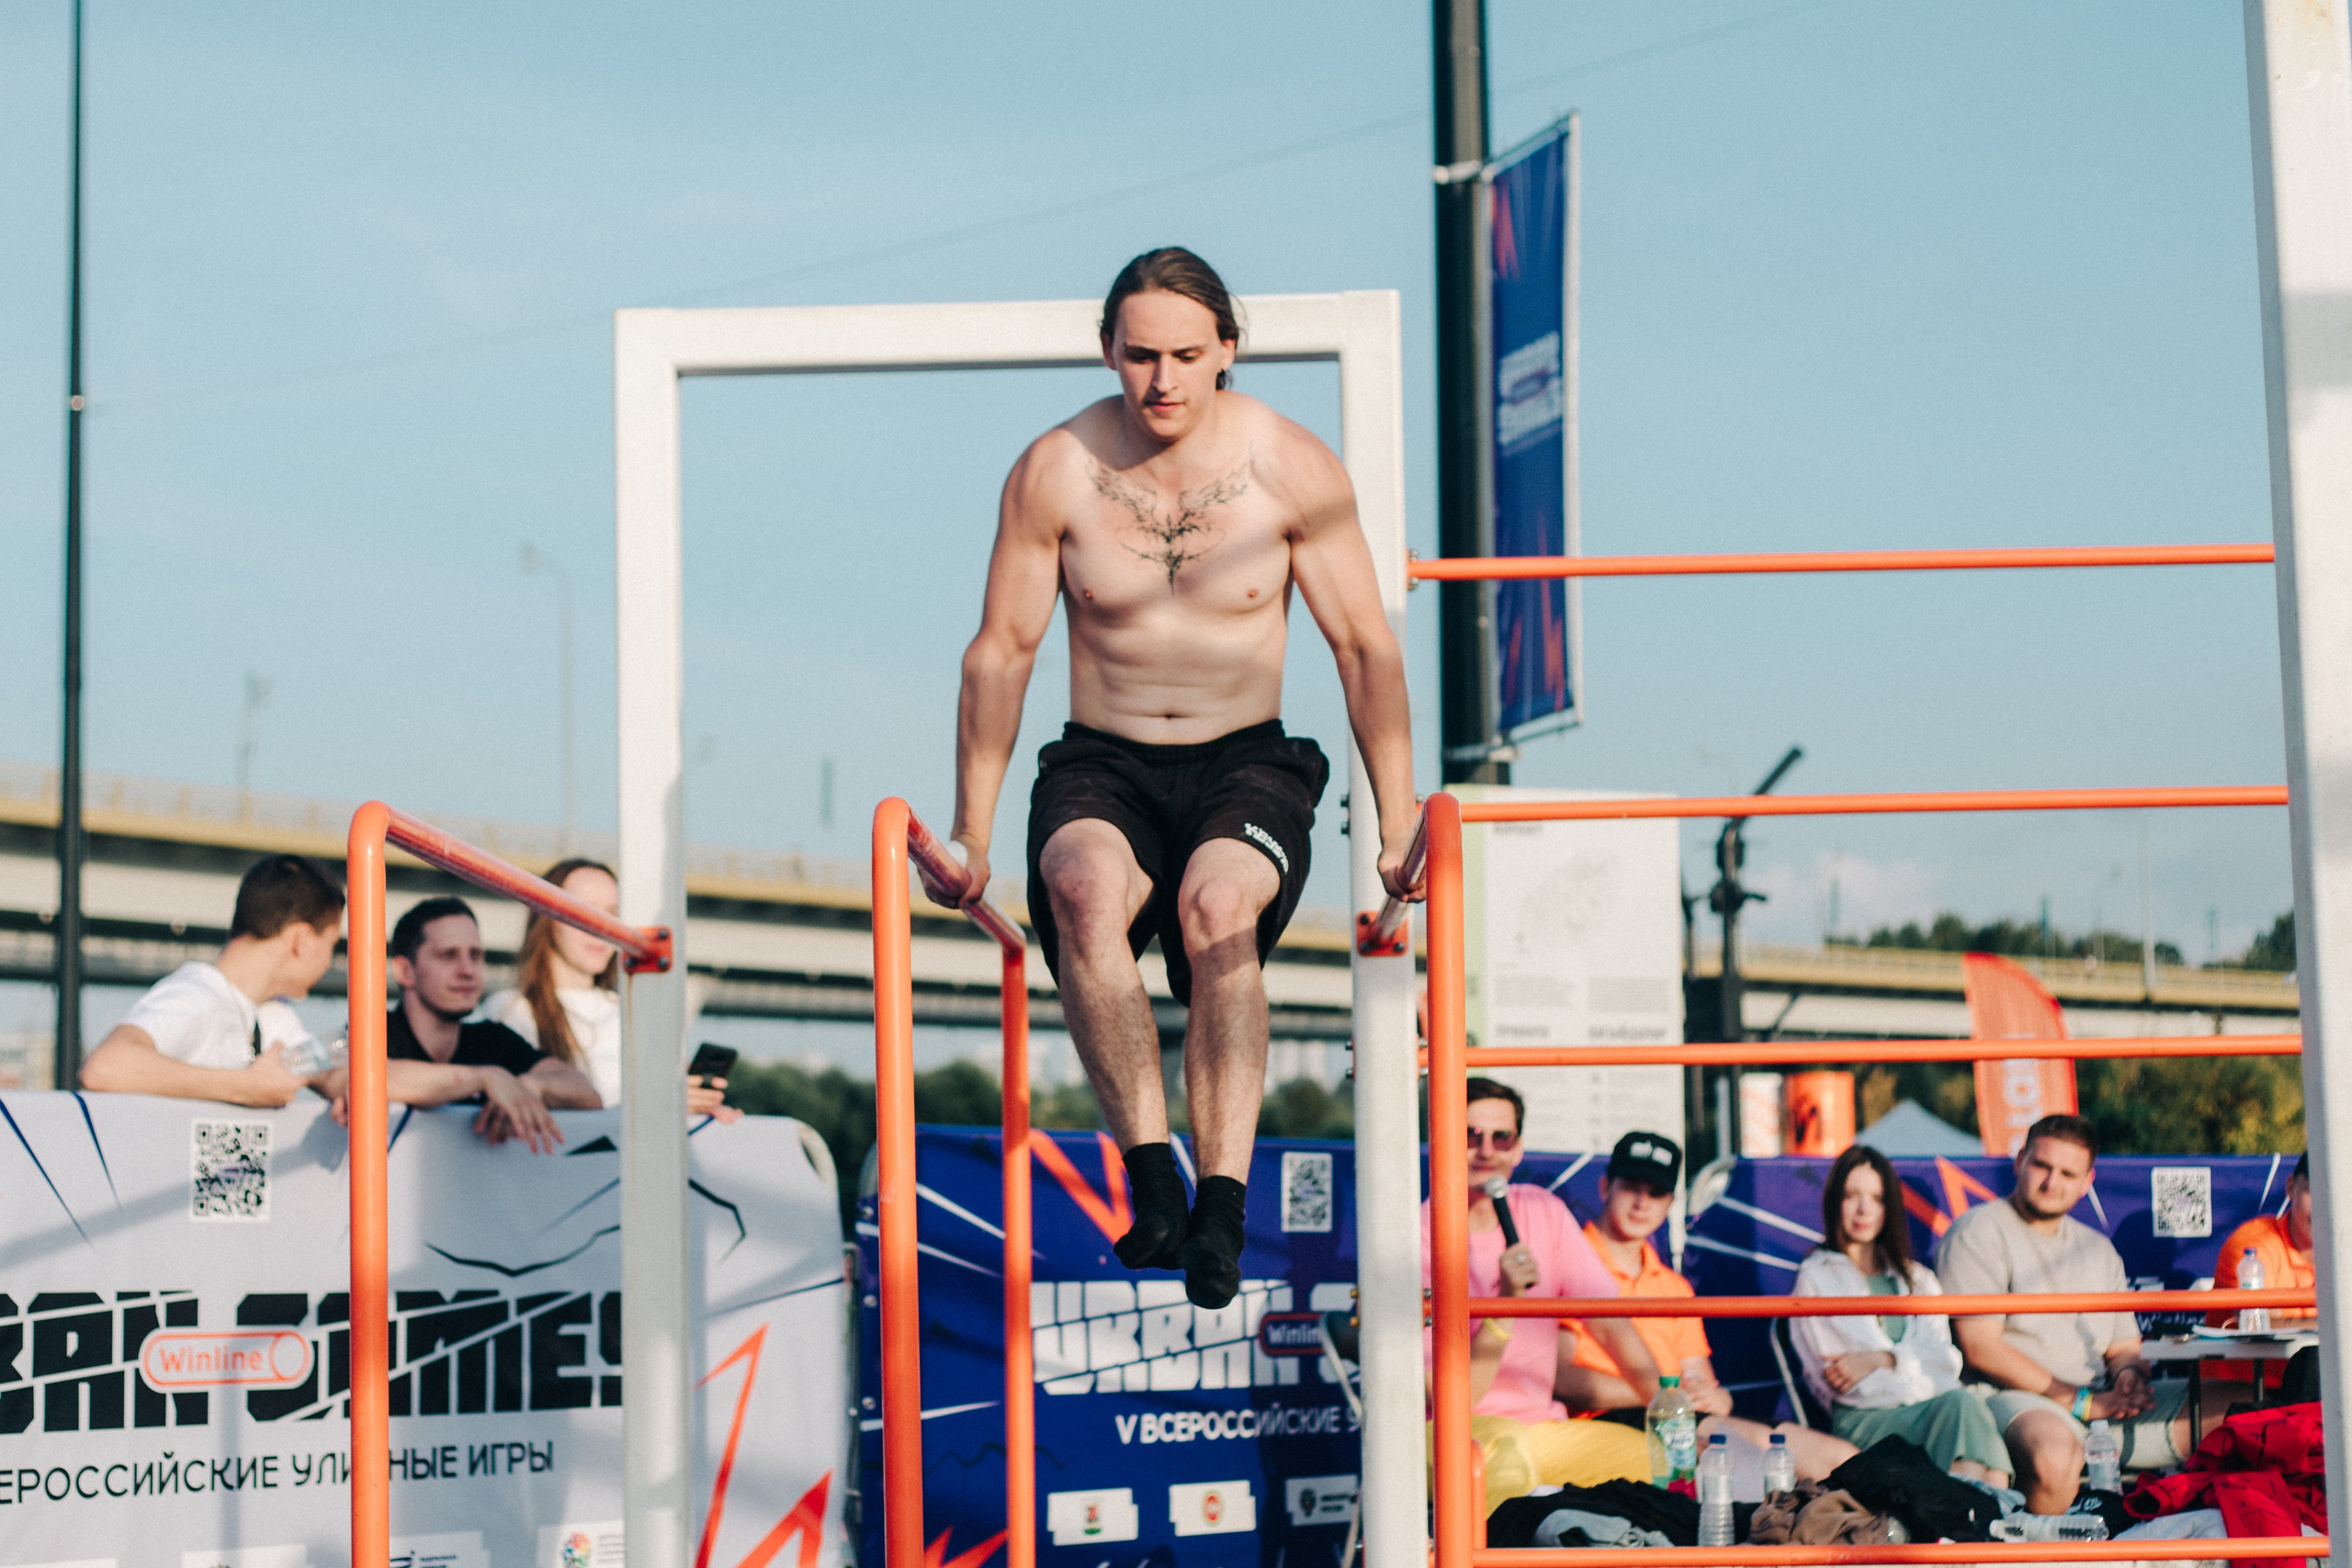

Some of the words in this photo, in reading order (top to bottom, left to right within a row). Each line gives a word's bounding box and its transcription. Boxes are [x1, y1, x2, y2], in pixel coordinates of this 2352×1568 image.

[1268, 1323, 1323, 1345] Winlin
[159, 1345, 263, 1373] Winline
[1114, 1415, 1138, 1445] V
[1139, 1402, 1340, 1445] ВСЕРОССИЙСКИЕ
[292, 1446, 458, 1486] УЛИНЫЕ
[468, 1441, 554, 1475] ИГРЫ
